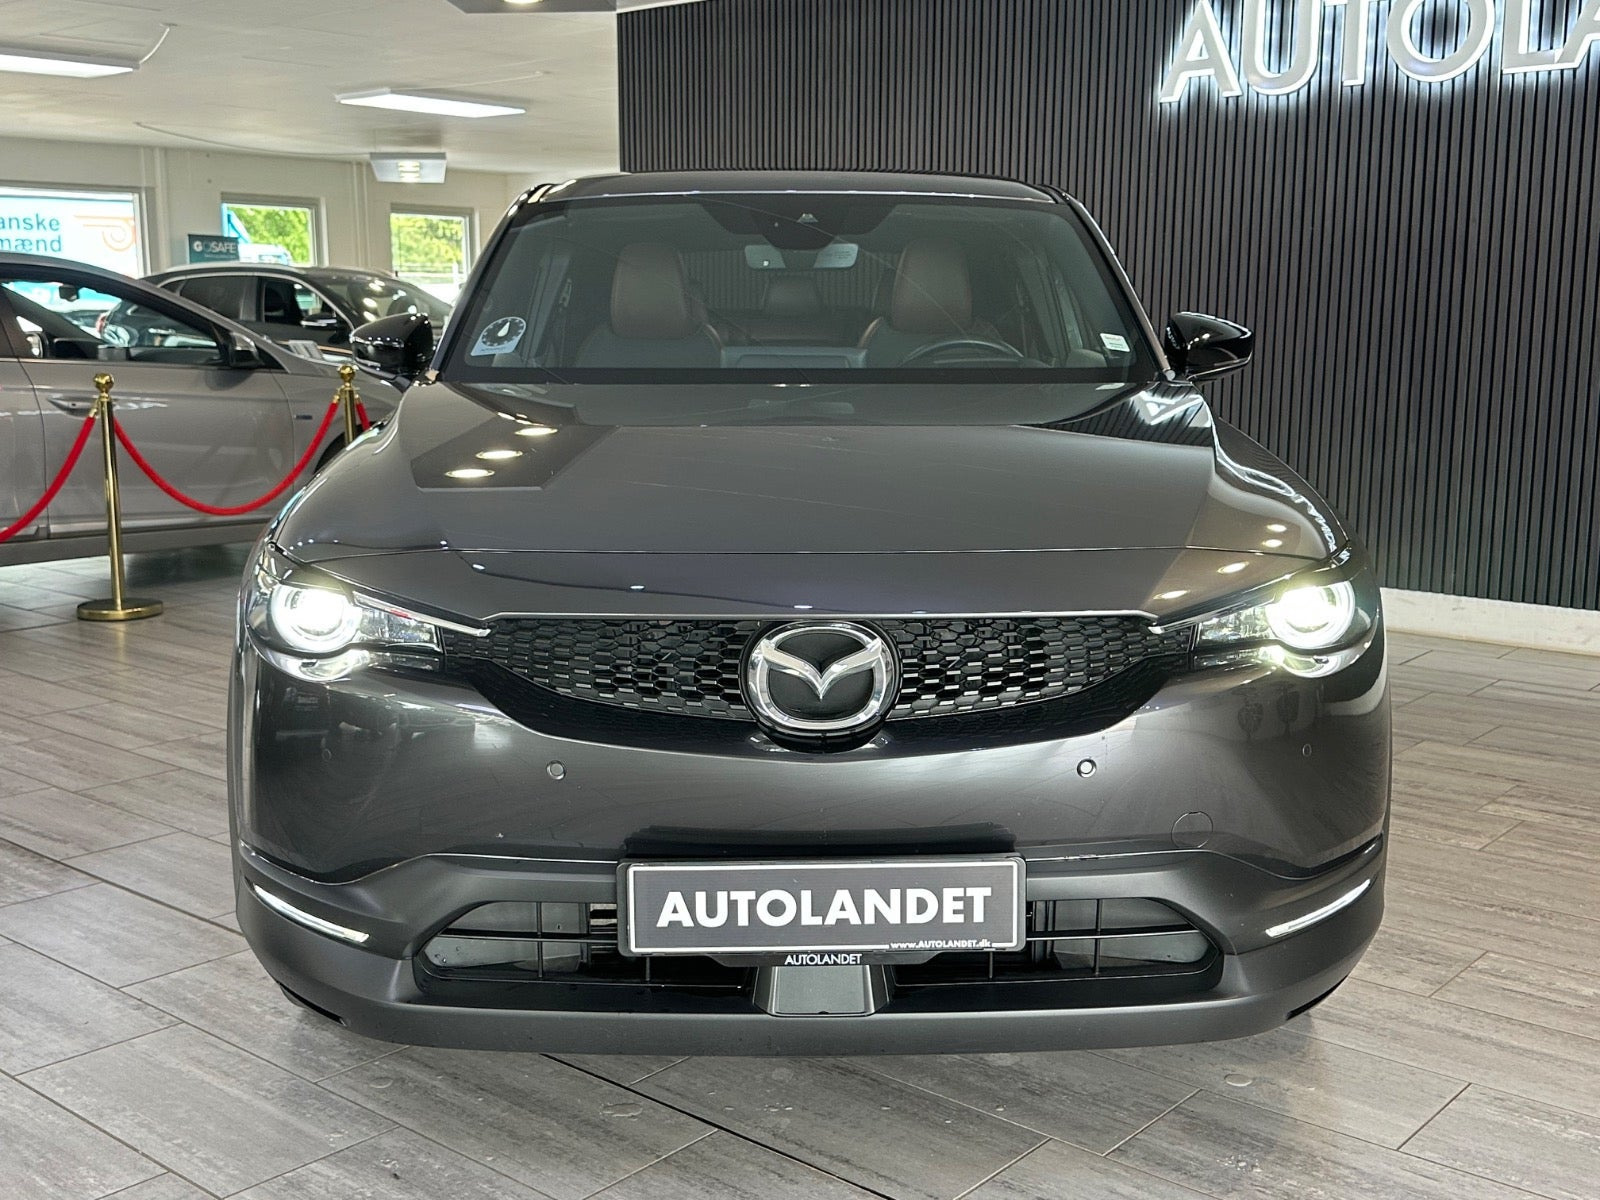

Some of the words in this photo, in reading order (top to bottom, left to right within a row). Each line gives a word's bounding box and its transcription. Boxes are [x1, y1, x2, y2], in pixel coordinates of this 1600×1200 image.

[656, 887, 992, 928] AUTOLANDET
[890, 939, 991, 949] www.AUTOLANDET.dk
[784, 953, 863, 966] AUTOLANDET
